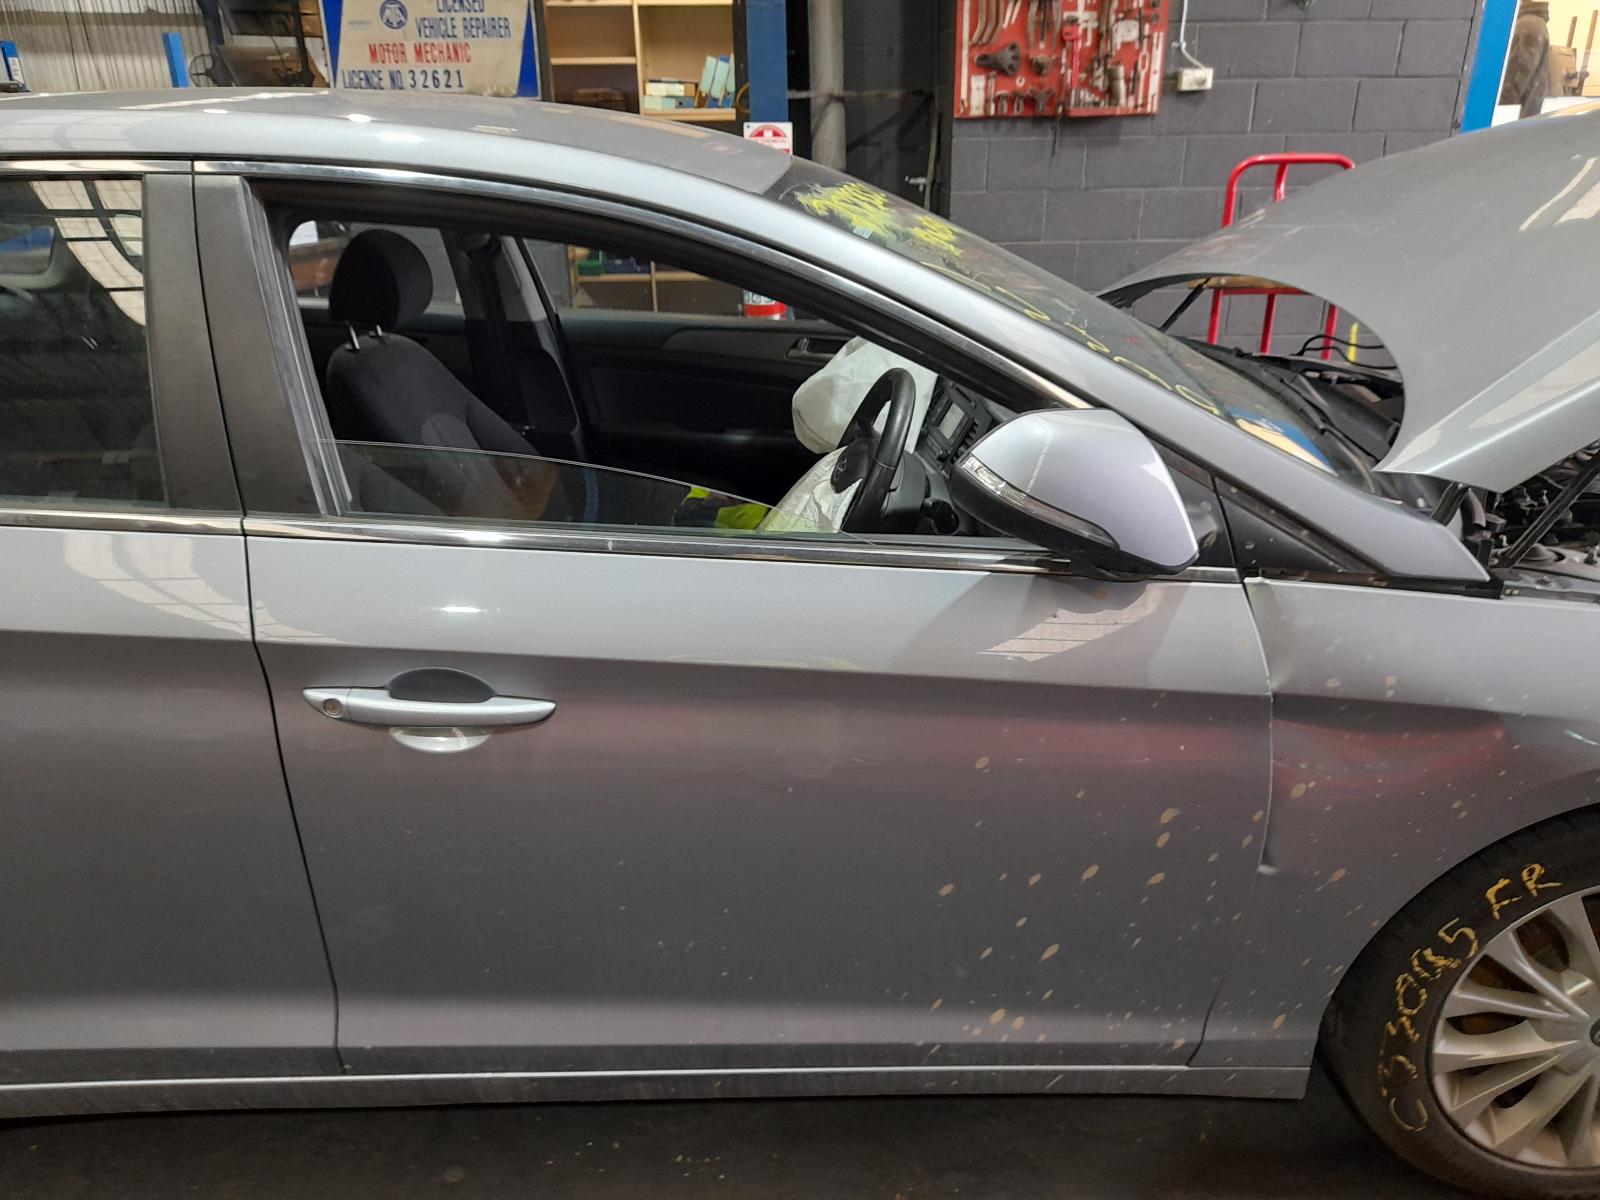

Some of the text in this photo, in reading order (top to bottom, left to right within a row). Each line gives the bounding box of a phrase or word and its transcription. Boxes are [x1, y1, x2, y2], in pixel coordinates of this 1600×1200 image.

[415, 17, 512, 39] VEHICLE REPAIRER
[368, 42, 472, 64] MOTOR MECHANIC
[341, 69, 384, 90] LICENCE
[408, 68, 464, 89] 32621
[1484, 863, 1563, 920] FR
